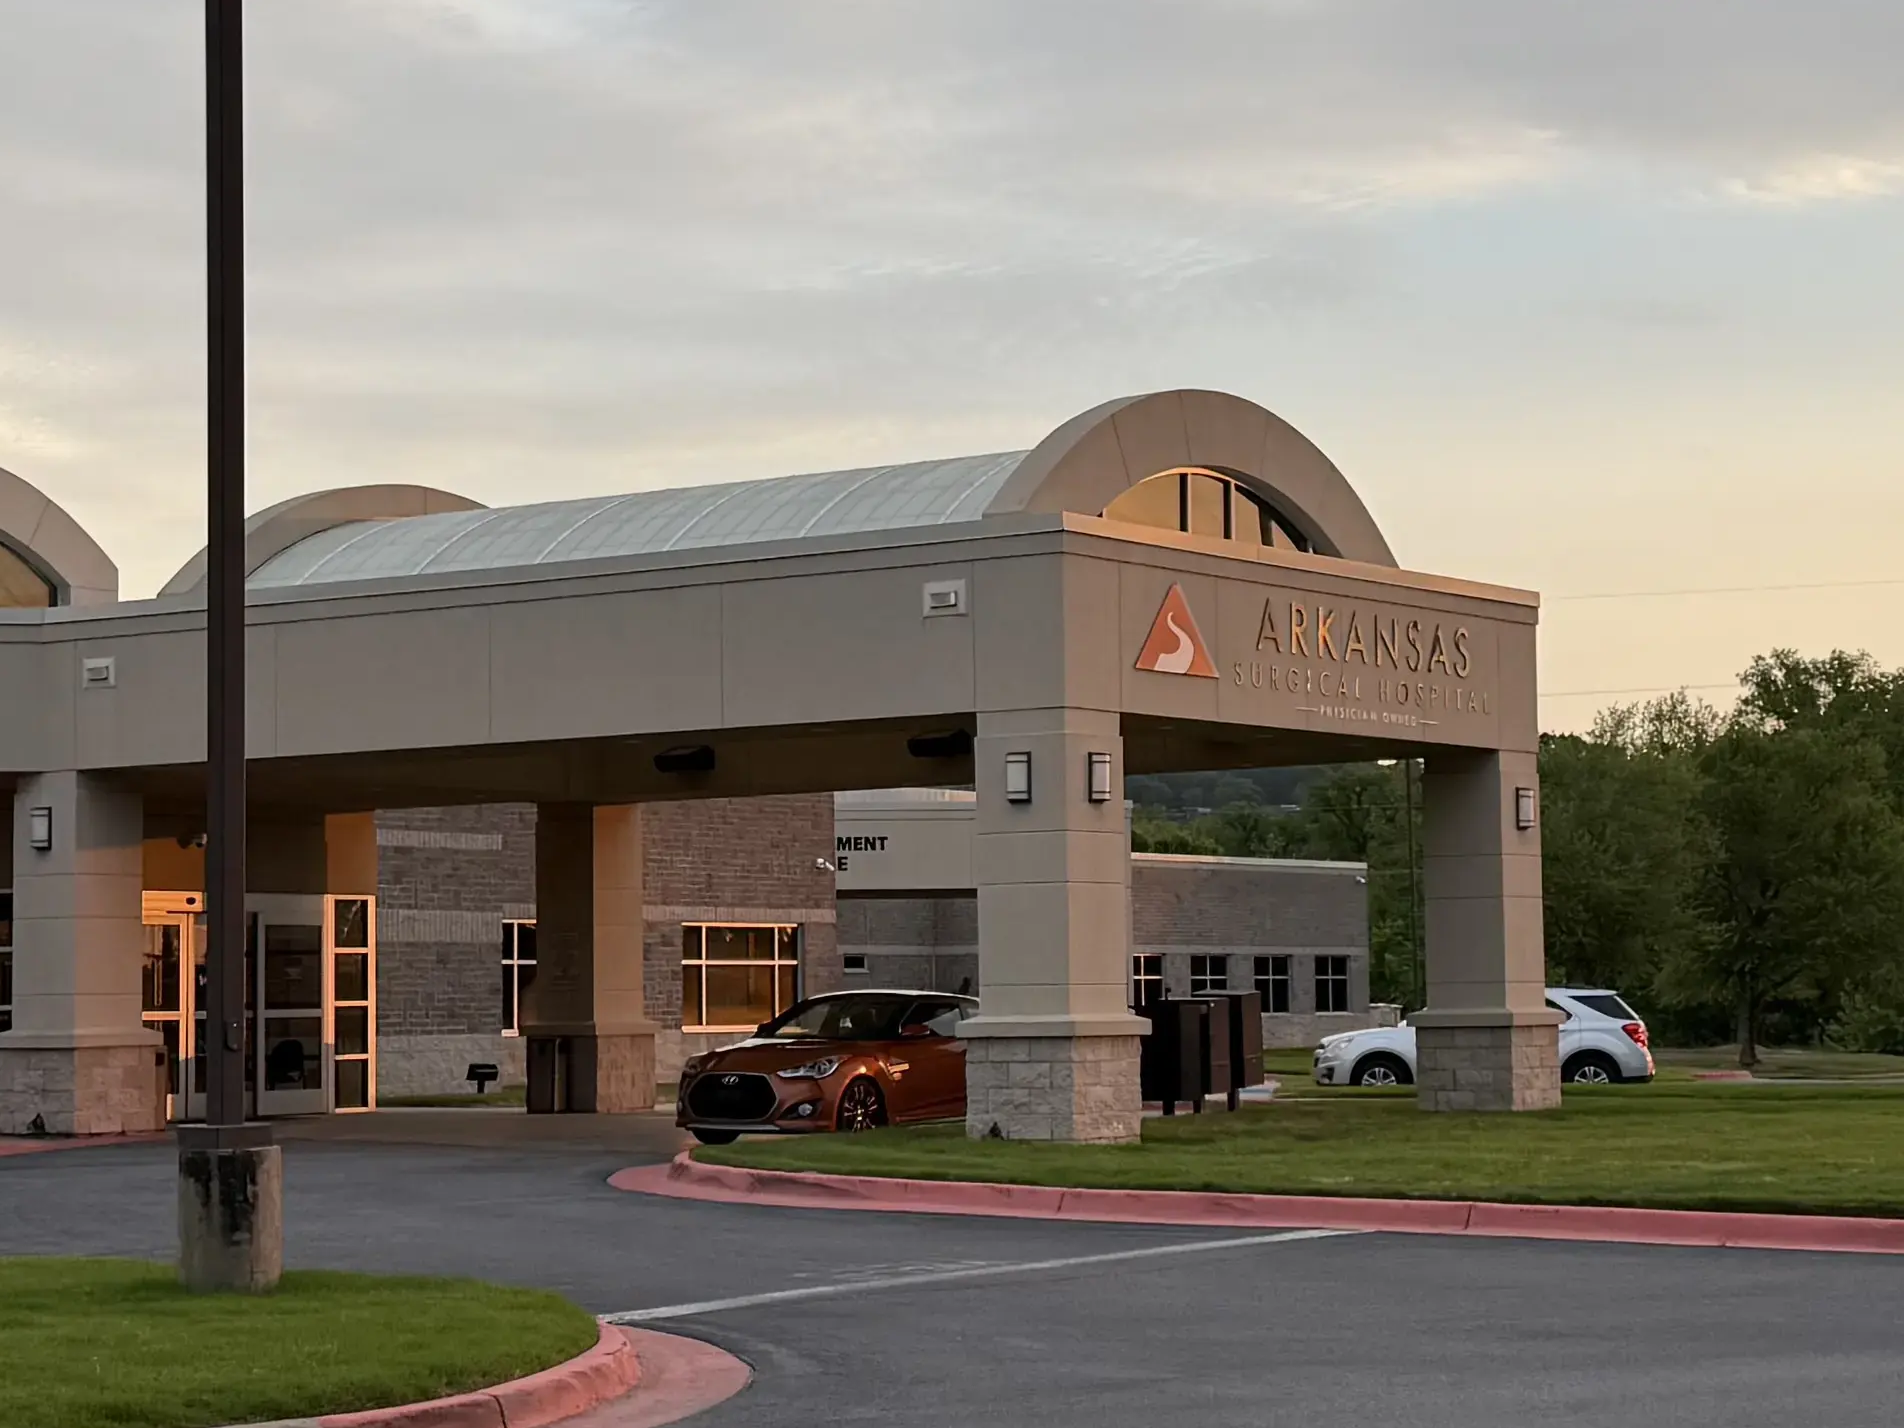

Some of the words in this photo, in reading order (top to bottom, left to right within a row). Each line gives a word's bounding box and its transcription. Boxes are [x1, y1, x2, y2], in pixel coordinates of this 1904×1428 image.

[1255, 596, 1471, 680] ARKANSAS
[1233, 661, 1362, 702] SURGICAL
[1378, 678, 1493, 716] HOSPITAL
